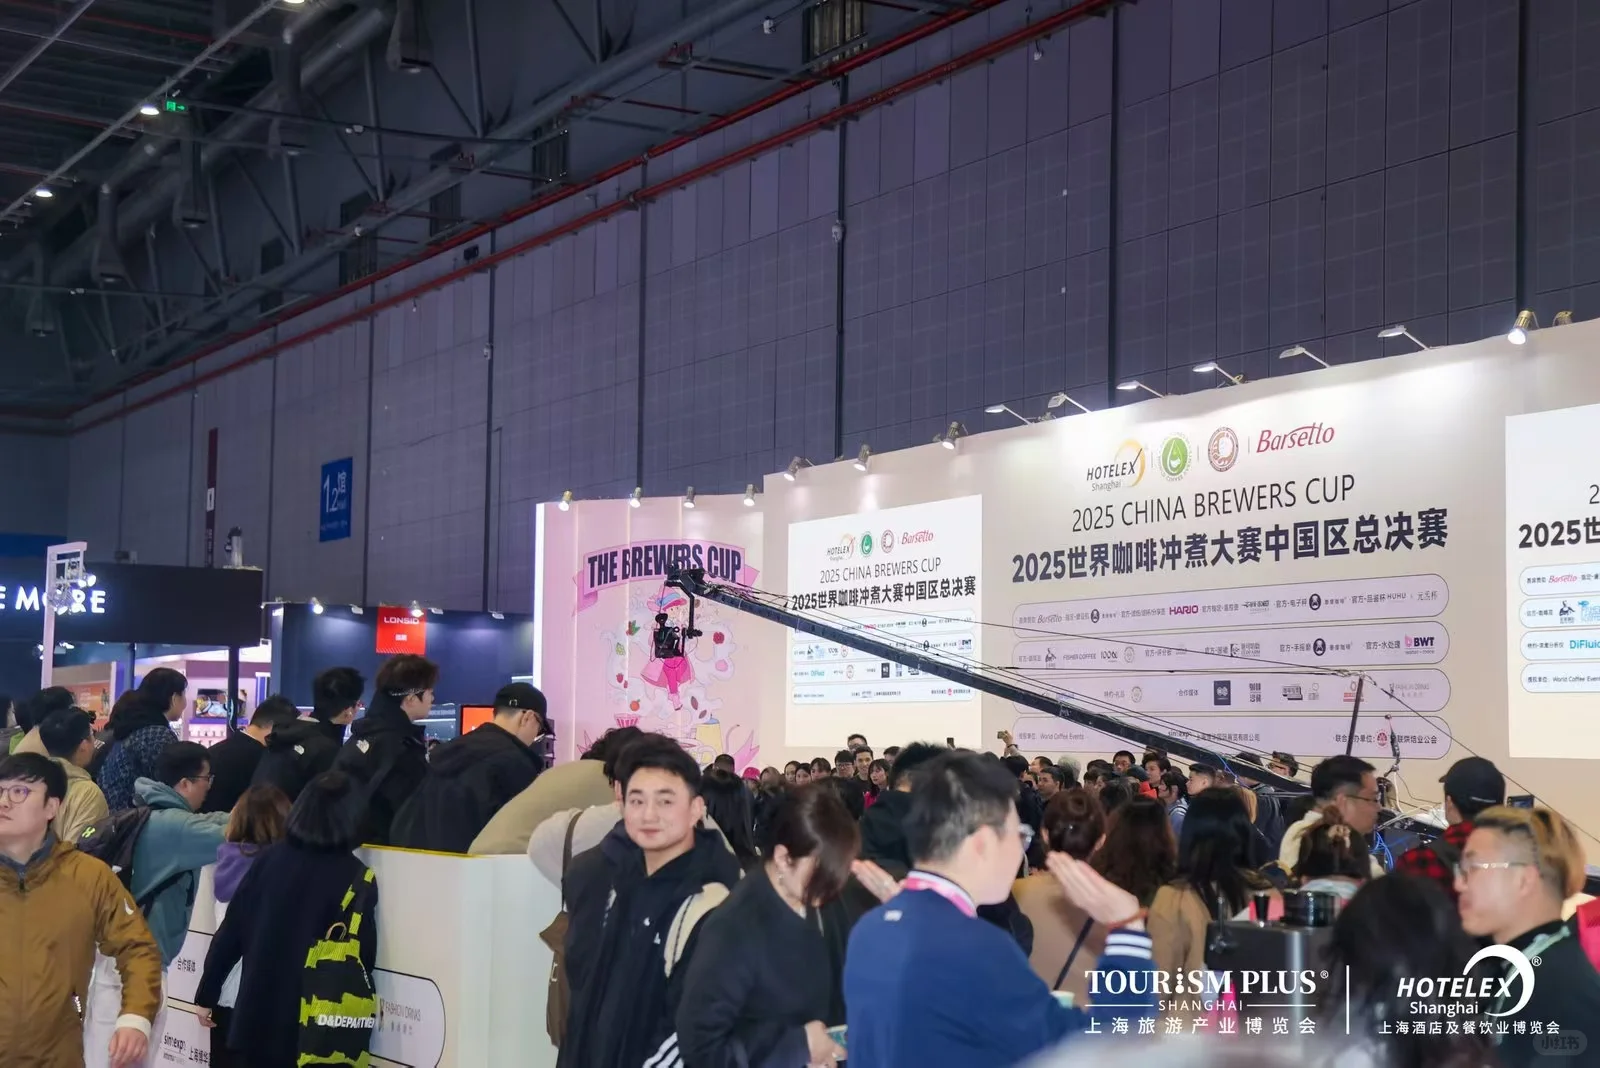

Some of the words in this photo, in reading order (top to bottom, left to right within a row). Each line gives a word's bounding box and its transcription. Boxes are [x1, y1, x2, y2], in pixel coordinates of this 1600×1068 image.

[1256, 422, 1335, 453] Barsetto
[1086, 451, 1142, 481] HOTELEX
[1091, 479, 1121, 492] Shanghai
[1072, 504, 1114, 532] 2025
[1121, 495, 1186, 526] CHINA
[1194, 480, 1296, 518] BREWERS
[1305, 474, 1355, 505] CUP
[901, 530, 934, 545] Barsetto
[1012, 508, 1449, 583] 2025世界咖啡冲煮大赛中国区总决赛
[587, 551, 618, 588] THE
[621, 543, 703, 580] BREWERS
[707, 545, 741, 583] CUP
[820, 570, 840, 584] 2025
[843, 565, 871, 582] CHINA
[874, 560, 918, 578] BREWERS
[921, 557, 941, 573] CUP
[15, 586, 106, 614] MRE
[792, 576, 976, 611] 2025世界咖啡冲煮大赛中国区总决赛
[383, 616, 420, 625] LONSID
[1169, 605, 1199, 616] HARIO
[1413, 636, 1435, 647] BWT
[1040, 732, 1053, 740] World
[1054, 732, 1068, 740] Coffee
[1070, 732, 1084, 740] Events
[1335, 734, 1375, 743] 联合办单位:
[1391, 735, 1437, 744] 联烘焙业公会
